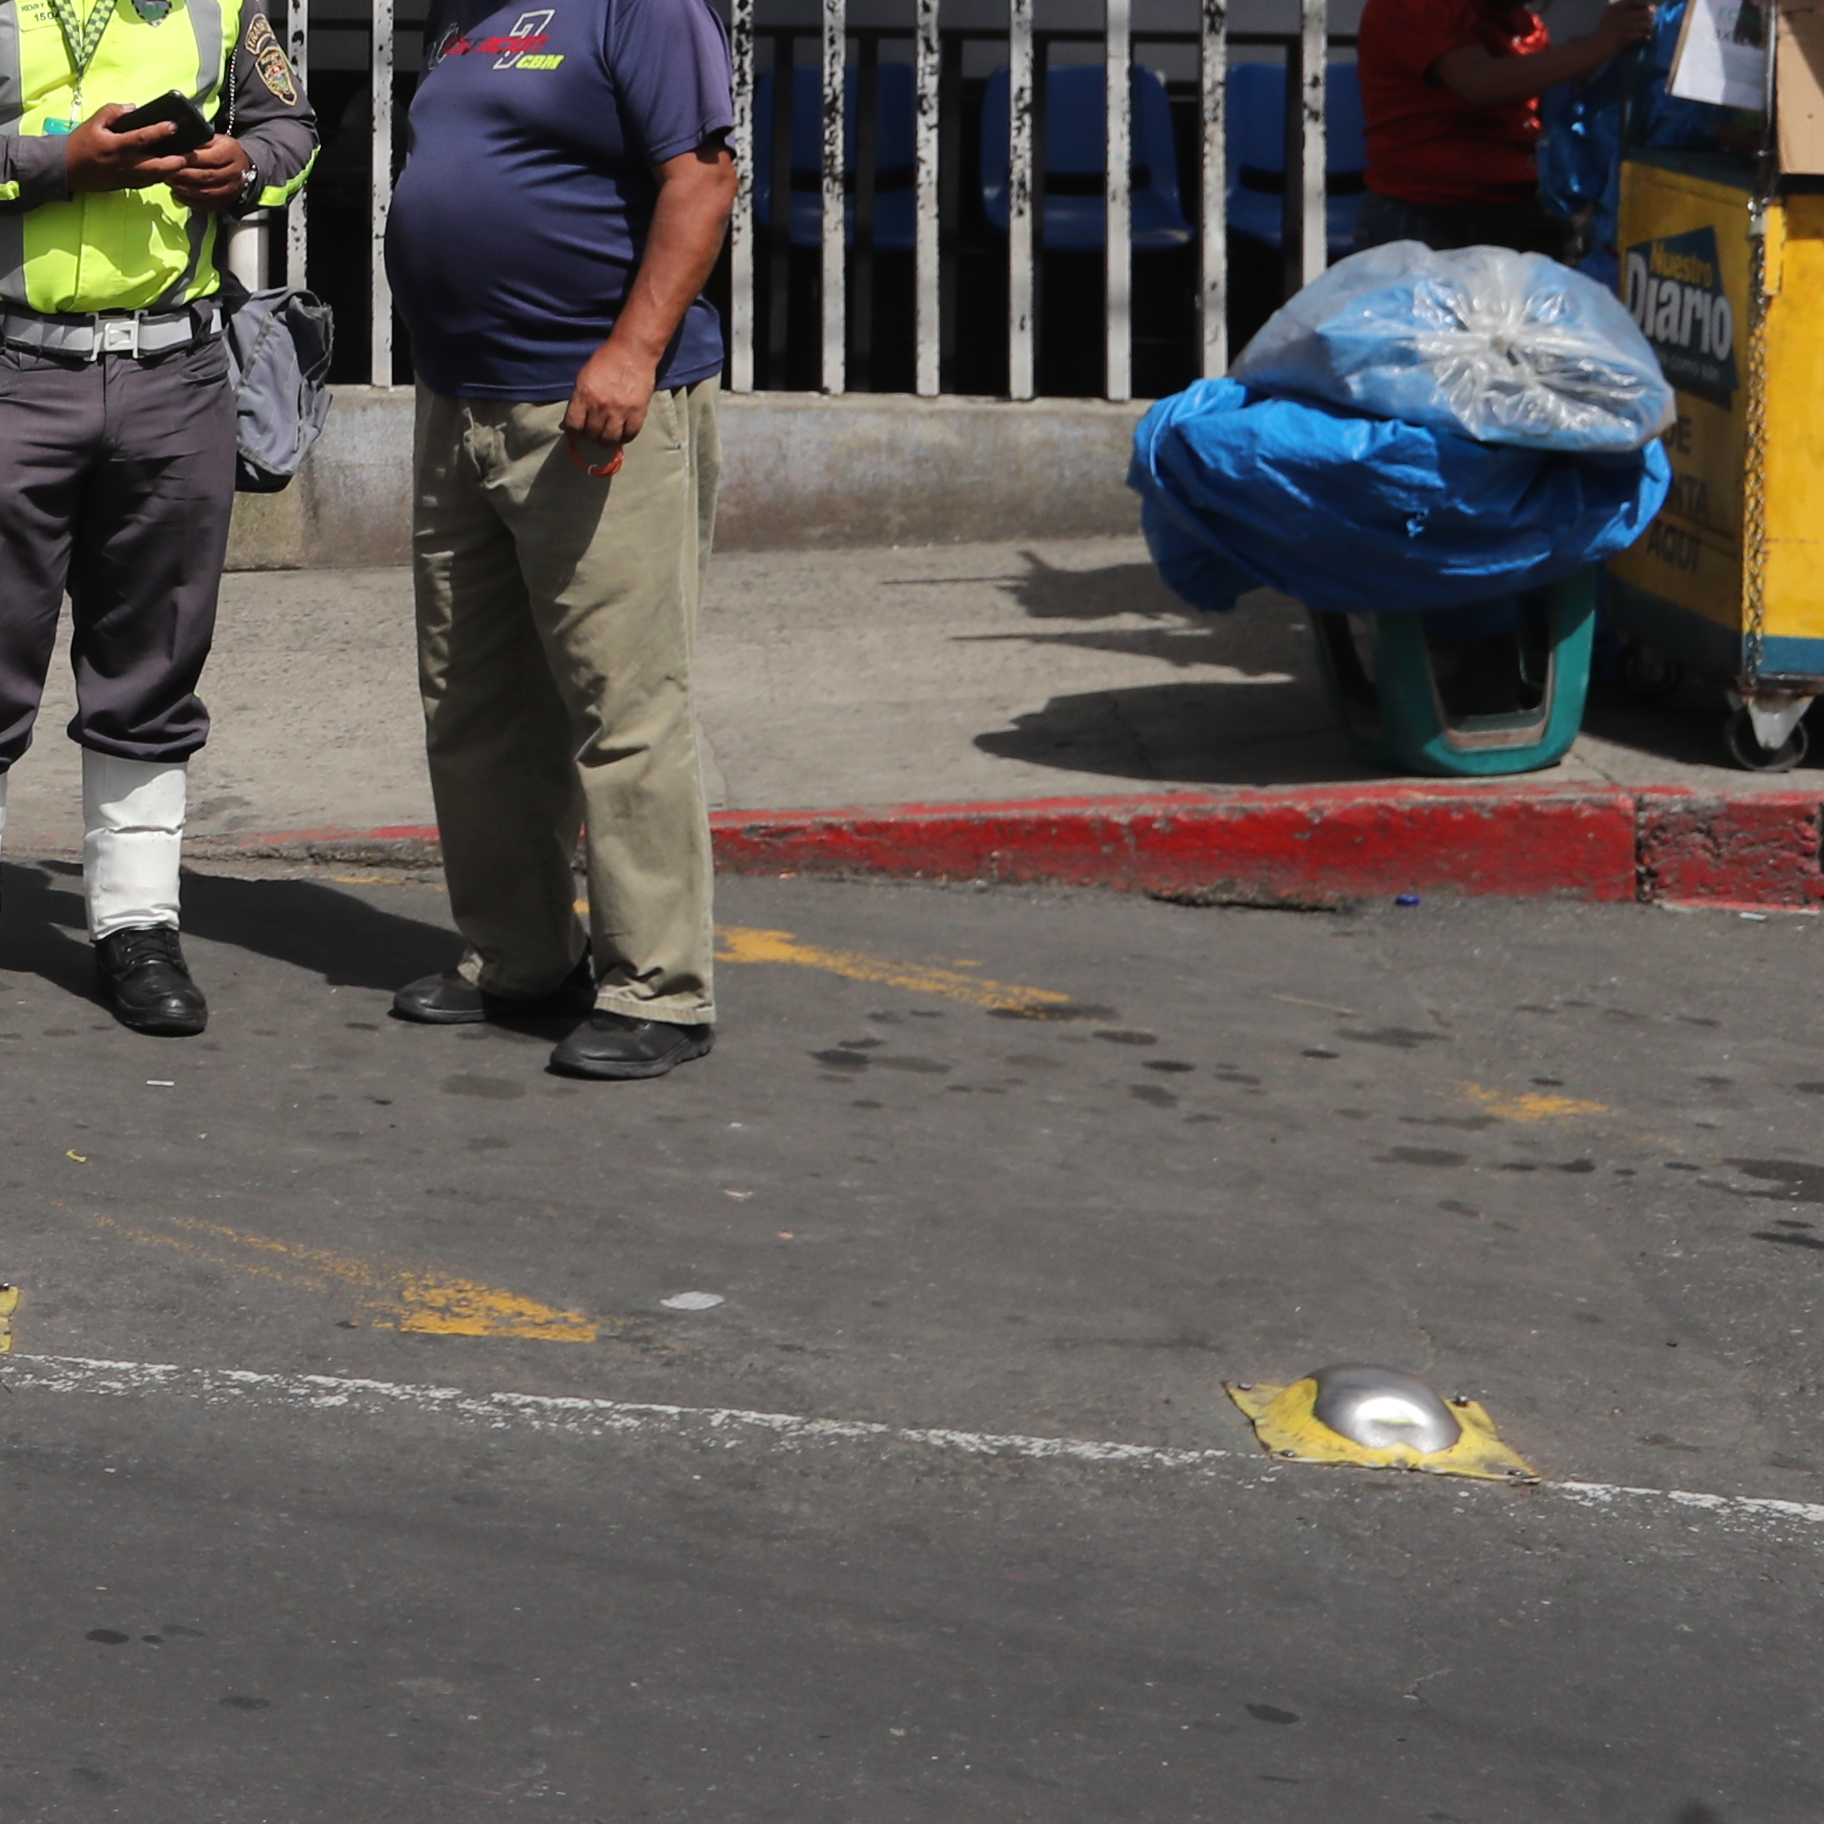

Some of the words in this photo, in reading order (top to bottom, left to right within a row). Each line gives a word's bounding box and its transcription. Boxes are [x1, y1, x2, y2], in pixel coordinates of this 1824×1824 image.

[515, 55, 565, 70] CBM
[1650, 240, 1713, 288] Nuestro
[1627, 250, 1733, 362] Diario
